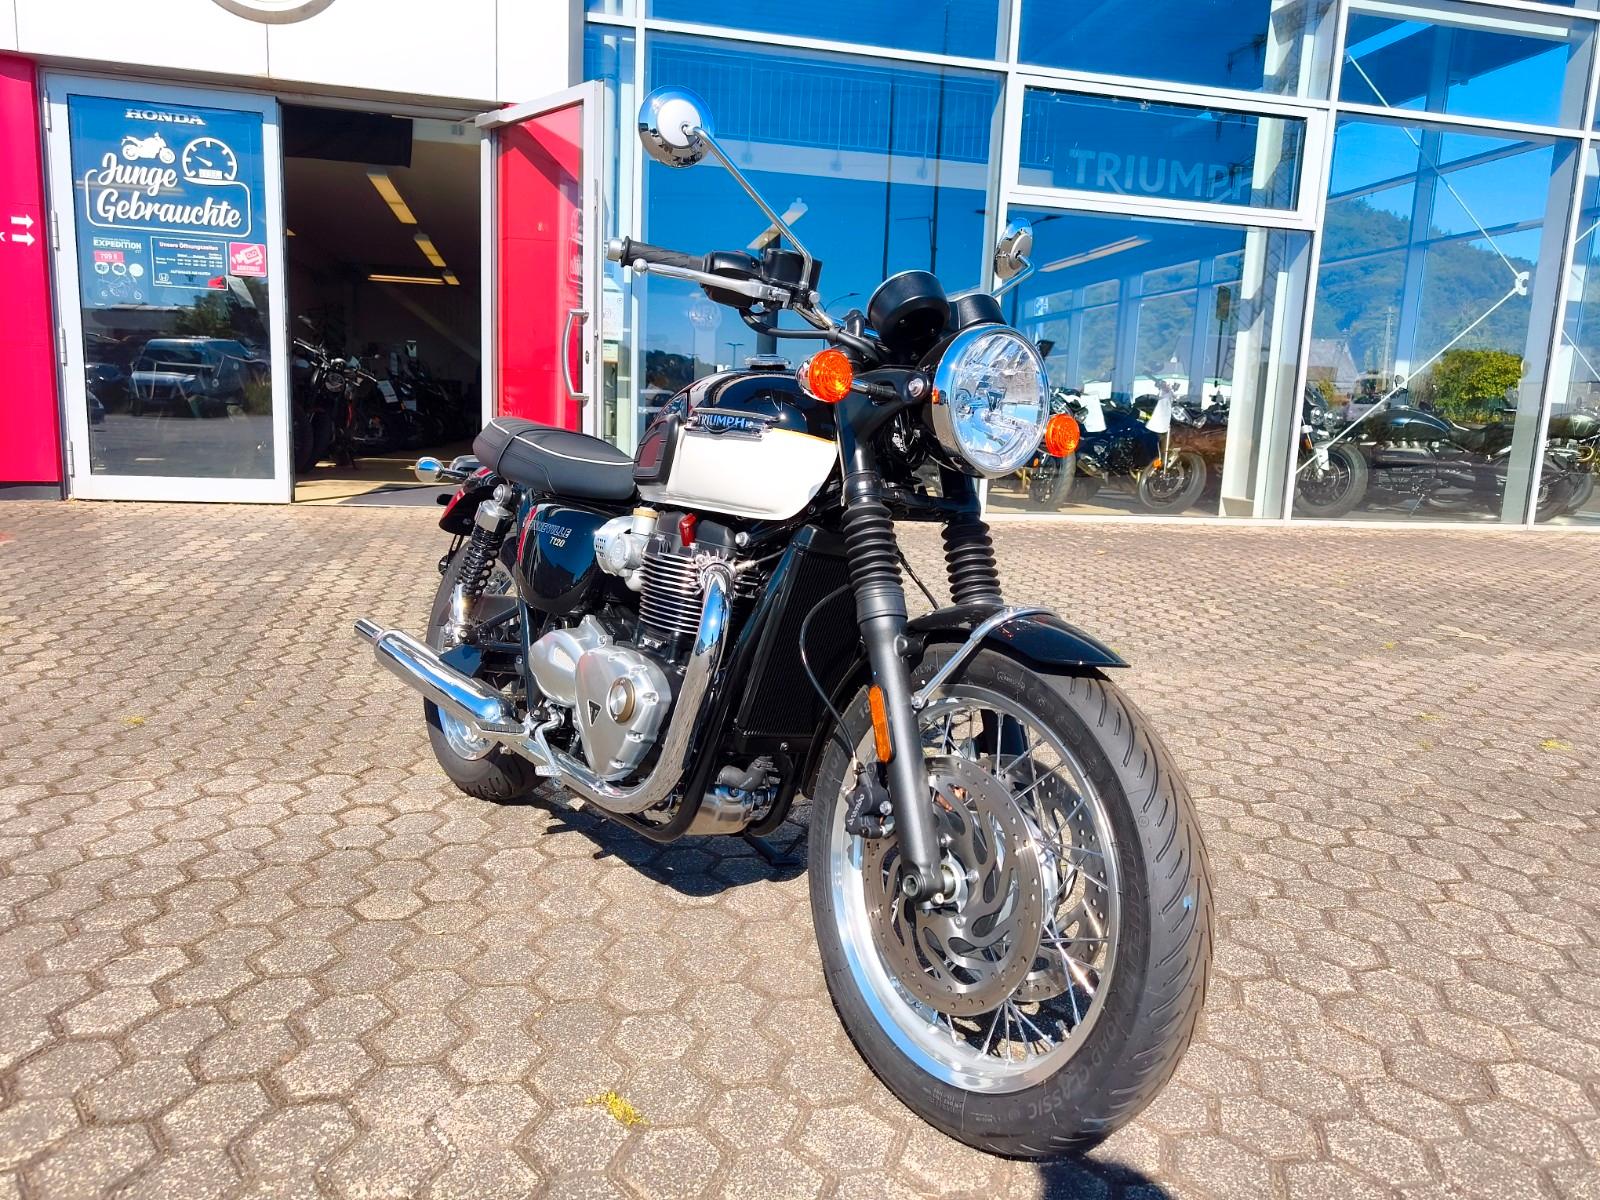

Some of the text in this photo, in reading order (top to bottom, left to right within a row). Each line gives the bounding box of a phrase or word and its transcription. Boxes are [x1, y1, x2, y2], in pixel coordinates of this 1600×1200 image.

[125, 108, 207, 126] HONDA
[97, 152, 178, 196] Junge
[96, 188, 242, 229] Gebrauchte
[93, 239, 142, 250] EXPEDITION
[697, 413, 746, 431] TRIUMPH
[549, 535, 566, 548] T120
